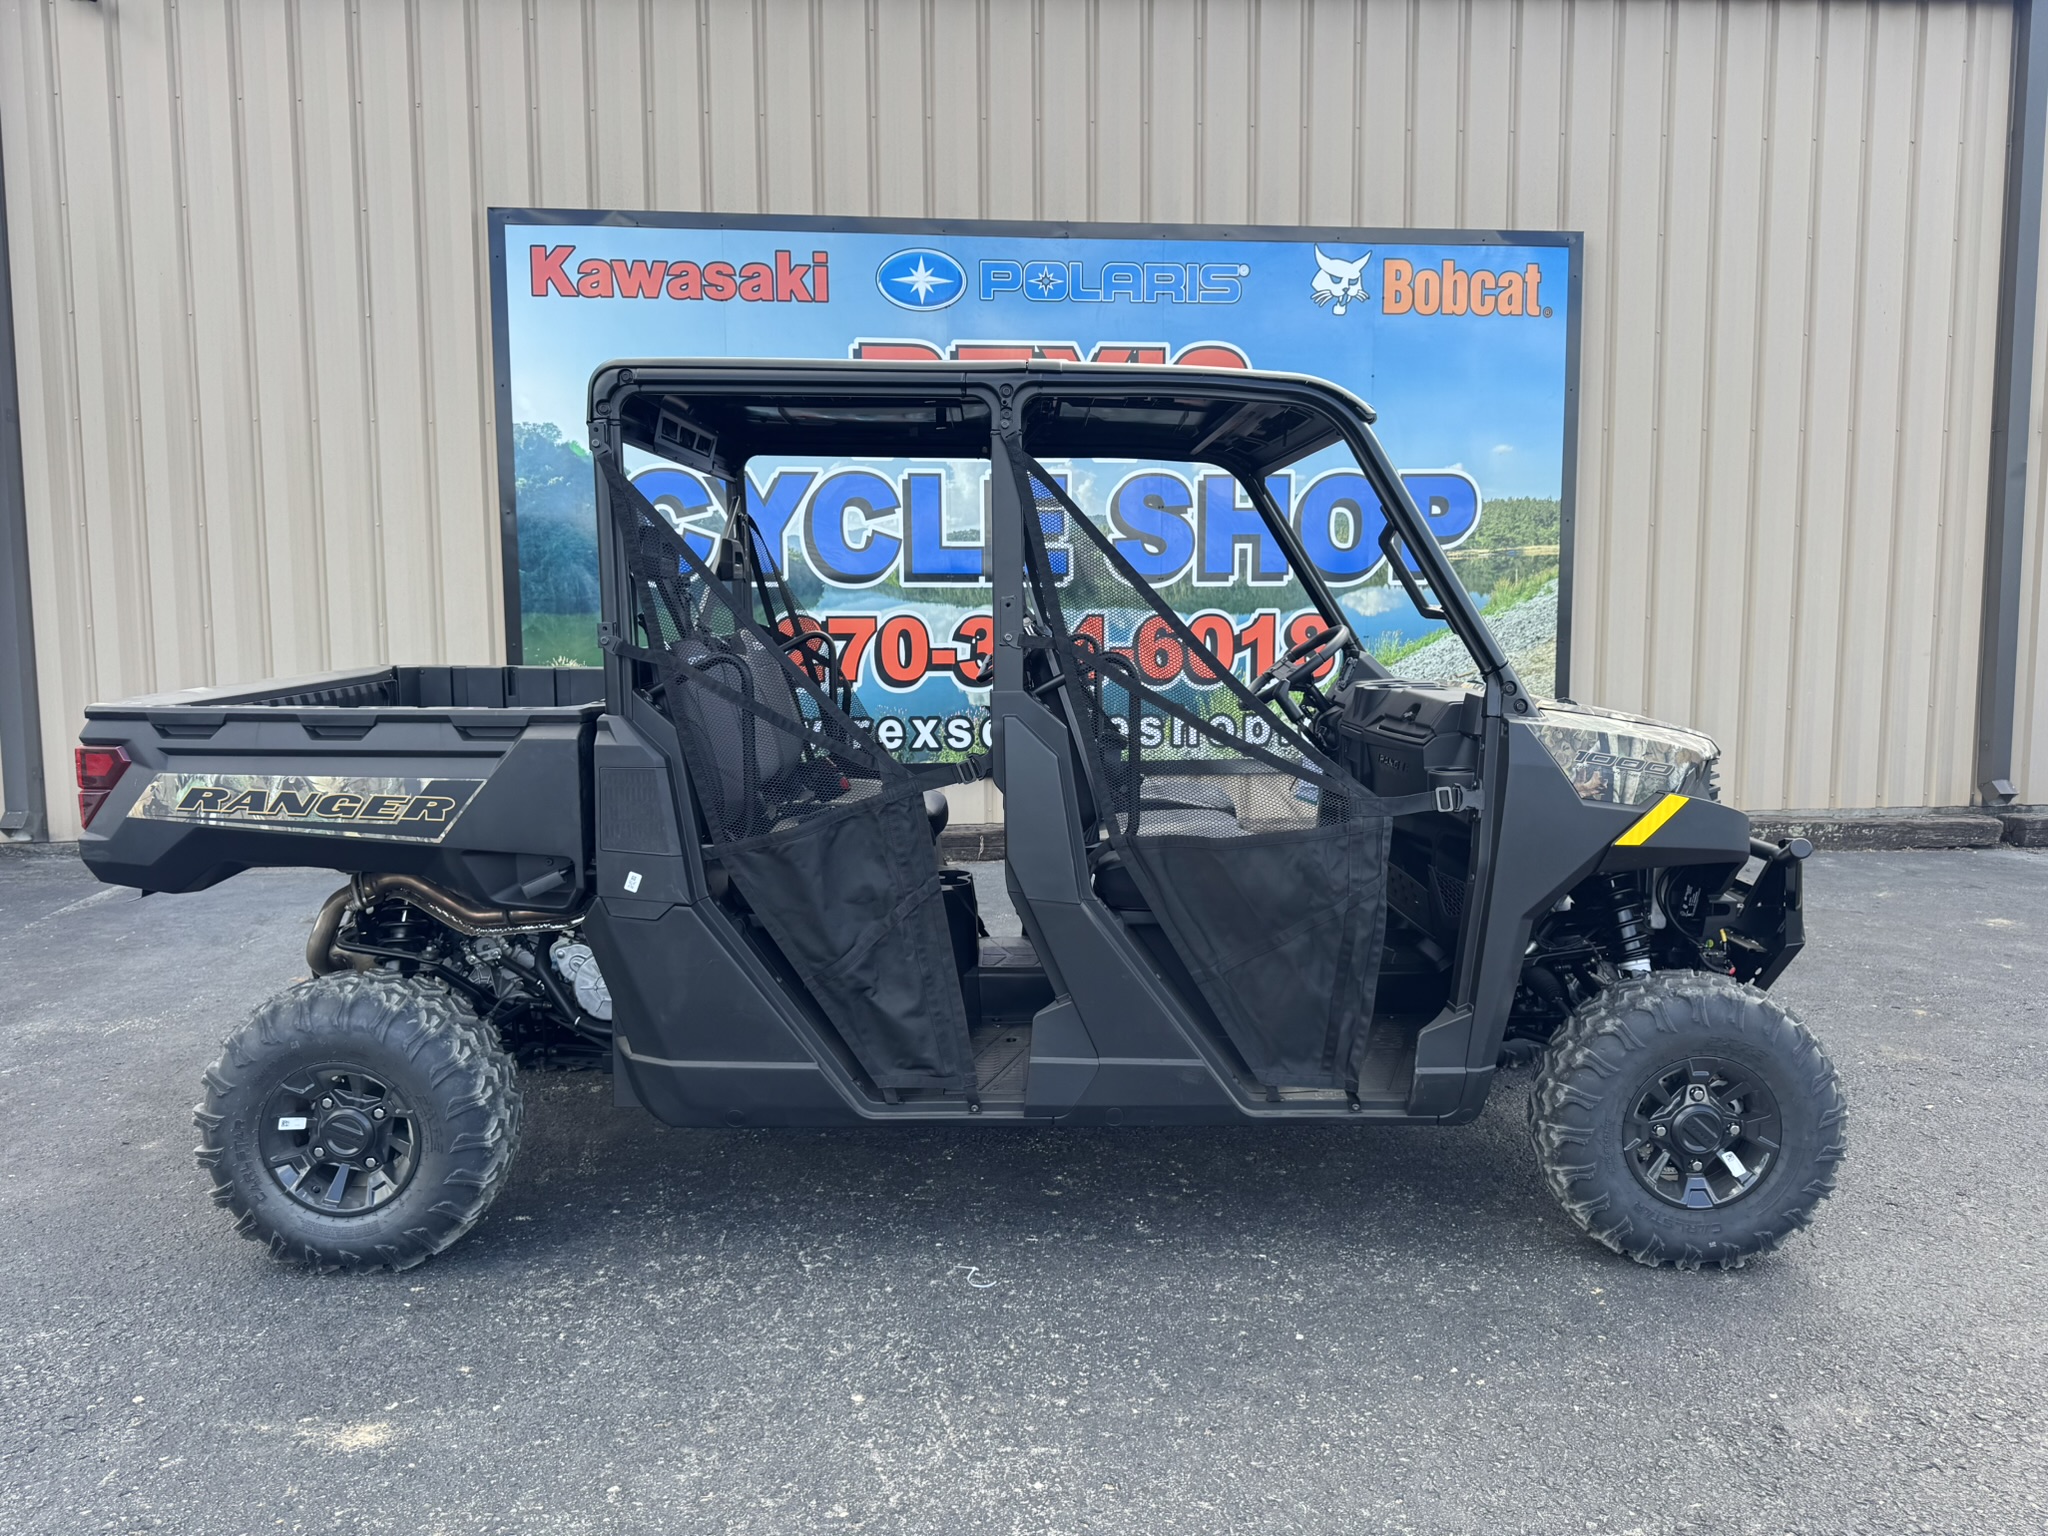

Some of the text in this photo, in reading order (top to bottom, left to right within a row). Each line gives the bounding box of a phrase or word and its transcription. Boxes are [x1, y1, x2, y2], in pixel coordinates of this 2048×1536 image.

[529, 245, 830, 303] Kawasaki
[979, 260, 1241, 303] POLARIS
[1110, 471, 1478, 584] SHOP
[1574, 750, 1676, 776] 1000
[176, 787, 456, 823] RANGER
